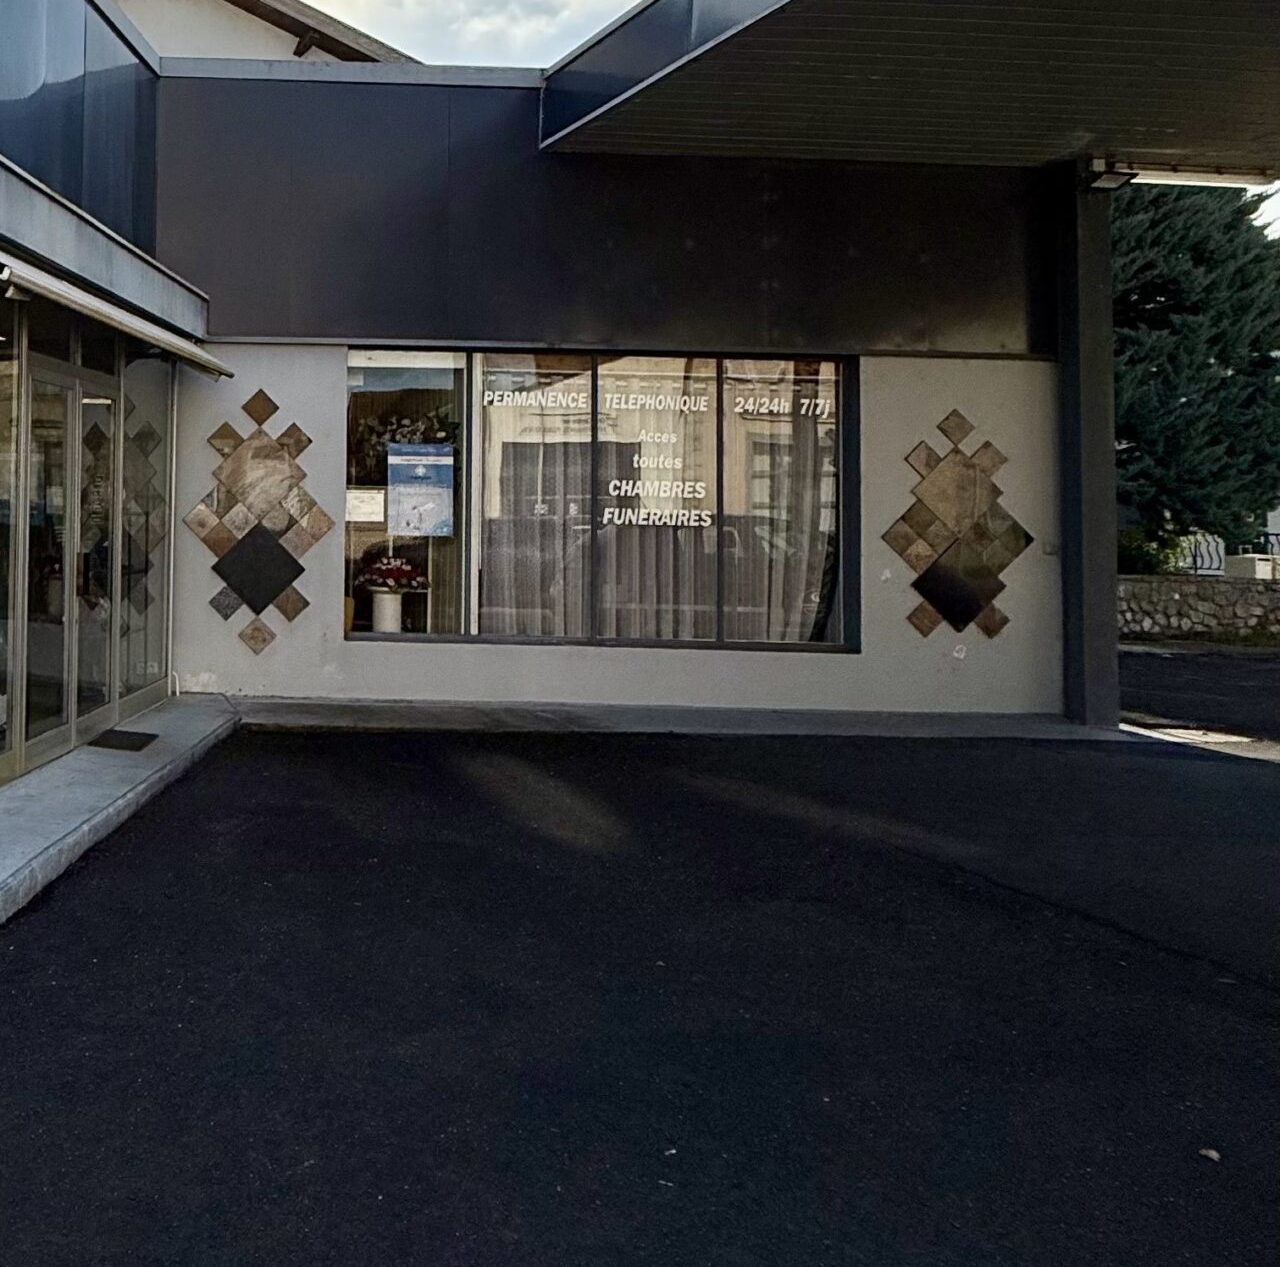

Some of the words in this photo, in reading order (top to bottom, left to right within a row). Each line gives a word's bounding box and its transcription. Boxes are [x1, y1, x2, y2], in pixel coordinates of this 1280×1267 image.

[483, 390, 588, 409] PERMANENCE
[604, 393, 709, 414] TELEPHONIQUE
[733, 396, 790, 415] 24/24h
[800, 398, 832, 417] 7/7j
[632, 452, 683, 469] toutes
[608, 479, 707, 499] CHAMBRES
[602, 507, 713, 527] FUNERAIRES
